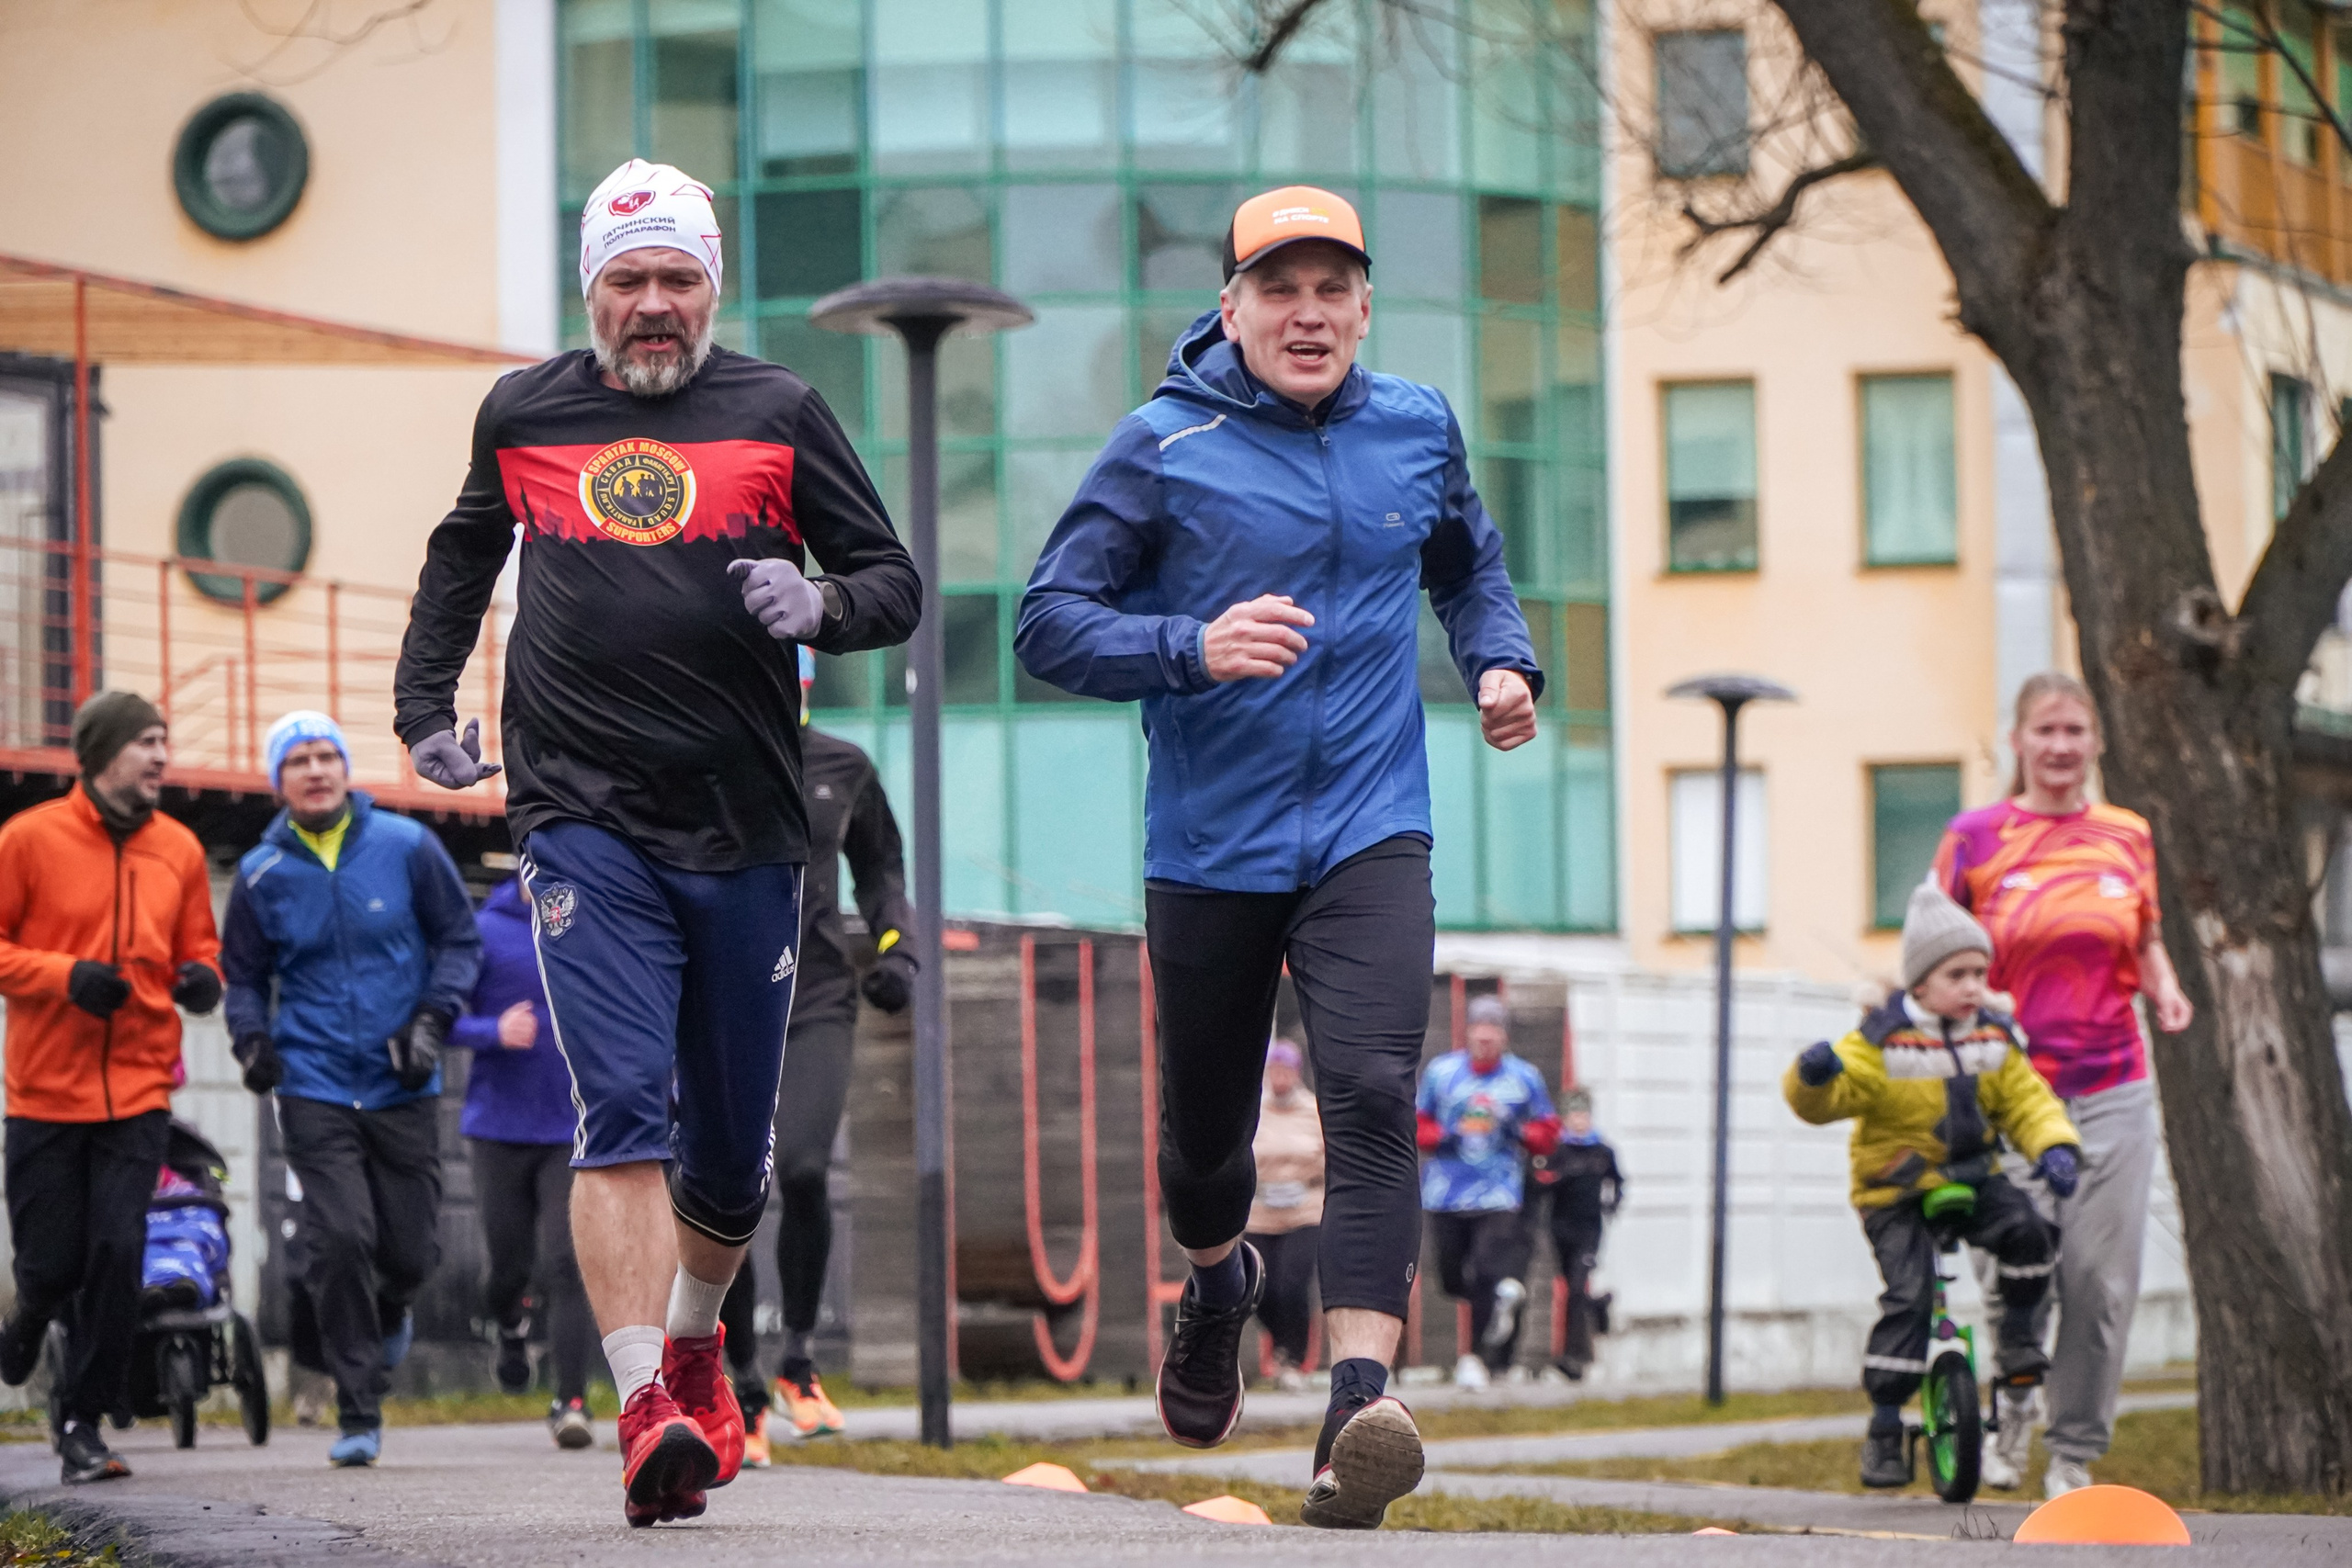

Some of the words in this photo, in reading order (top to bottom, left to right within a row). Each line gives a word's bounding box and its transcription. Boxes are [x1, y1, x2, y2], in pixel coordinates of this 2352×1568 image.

[602, 217, 675, 242] ГАТЧИНСКИЙ
[604, 225, 676, 250] ПОЛУМАРАФОН
[588, 442, 636, 473] SPARTAK
[639, 442, 685, 472] MOSCOW
[600, 457, 632, 484] СКВАД
[648, 497, 675, 525] SQUAD
[606, 522, 676, 543] SUPPORTERS
[772, 964, 795, 983] adidas
